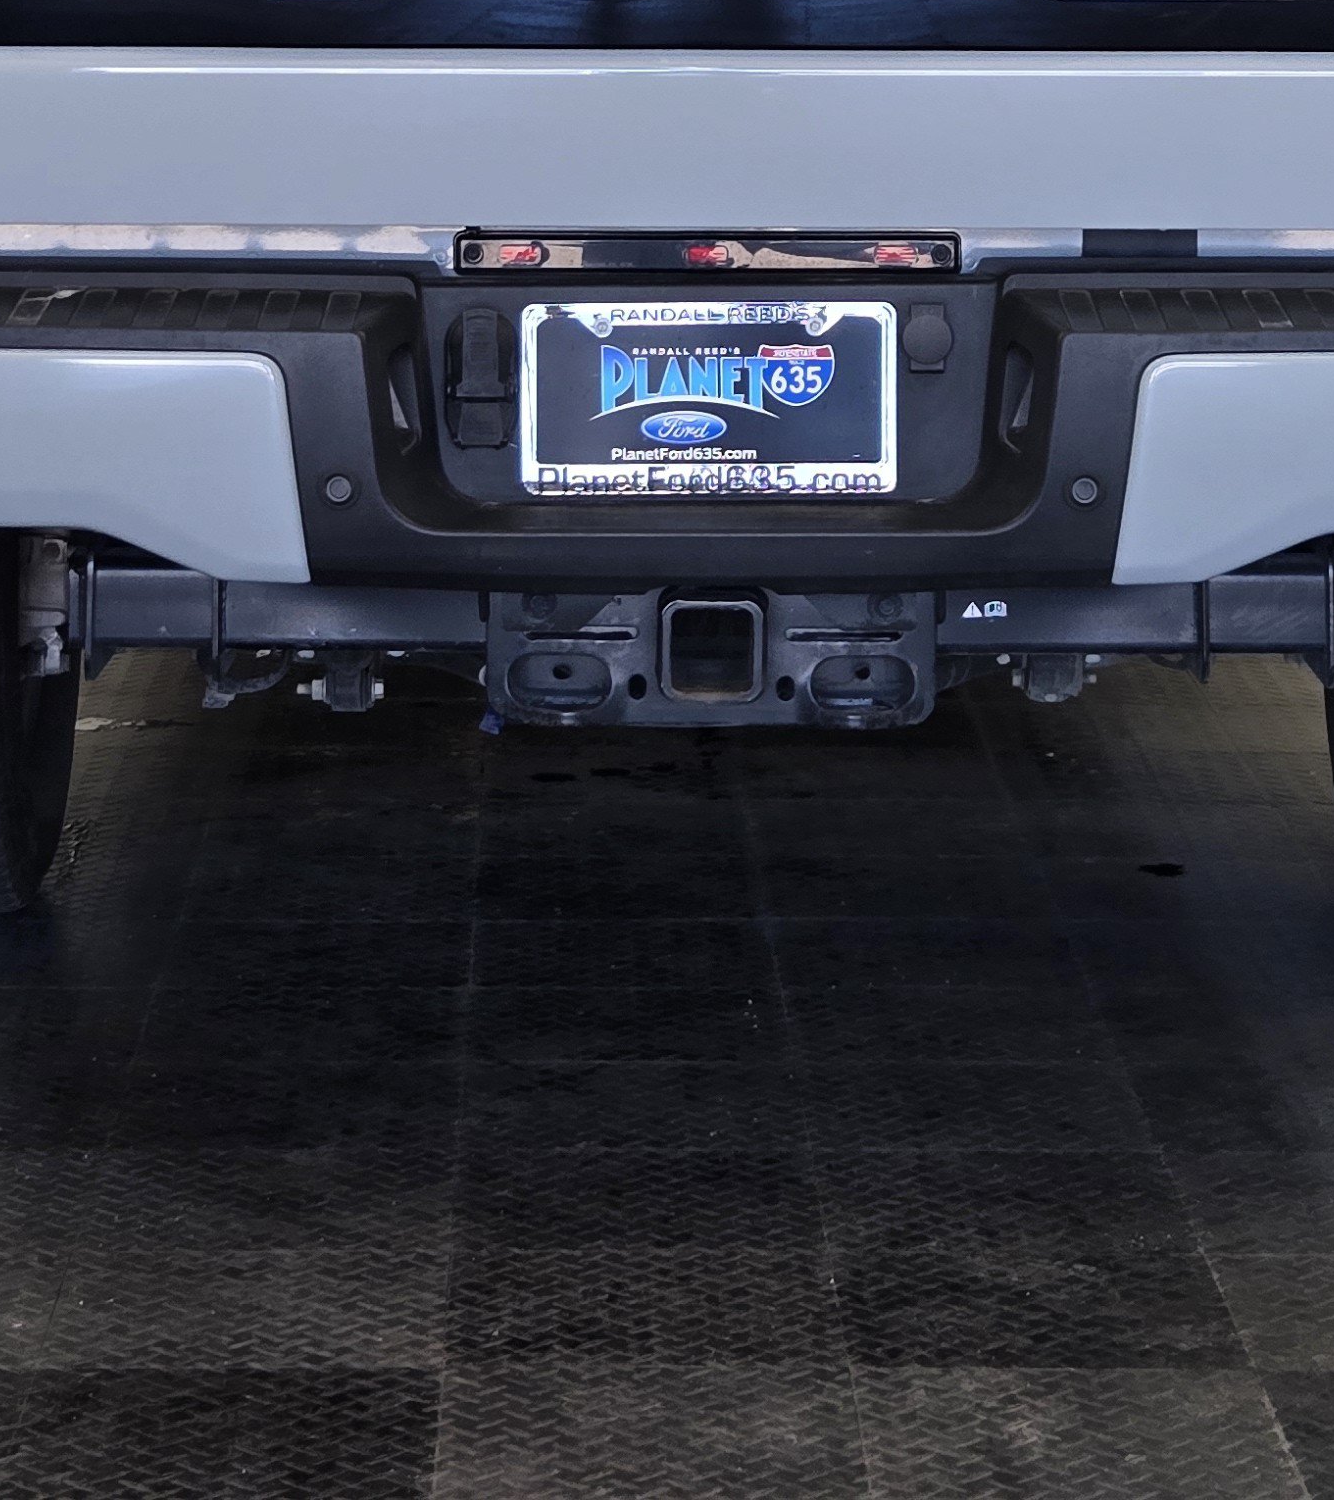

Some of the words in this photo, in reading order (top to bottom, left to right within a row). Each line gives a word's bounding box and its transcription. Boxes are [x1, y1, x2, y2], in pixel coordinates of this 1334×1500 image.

[601, 345, 769, 414] PLANET
[771, 365, 822, 394] 635
[658, 416, 709, 439] Ford
[610, 447, 757, 461] PlanetFord635.com
